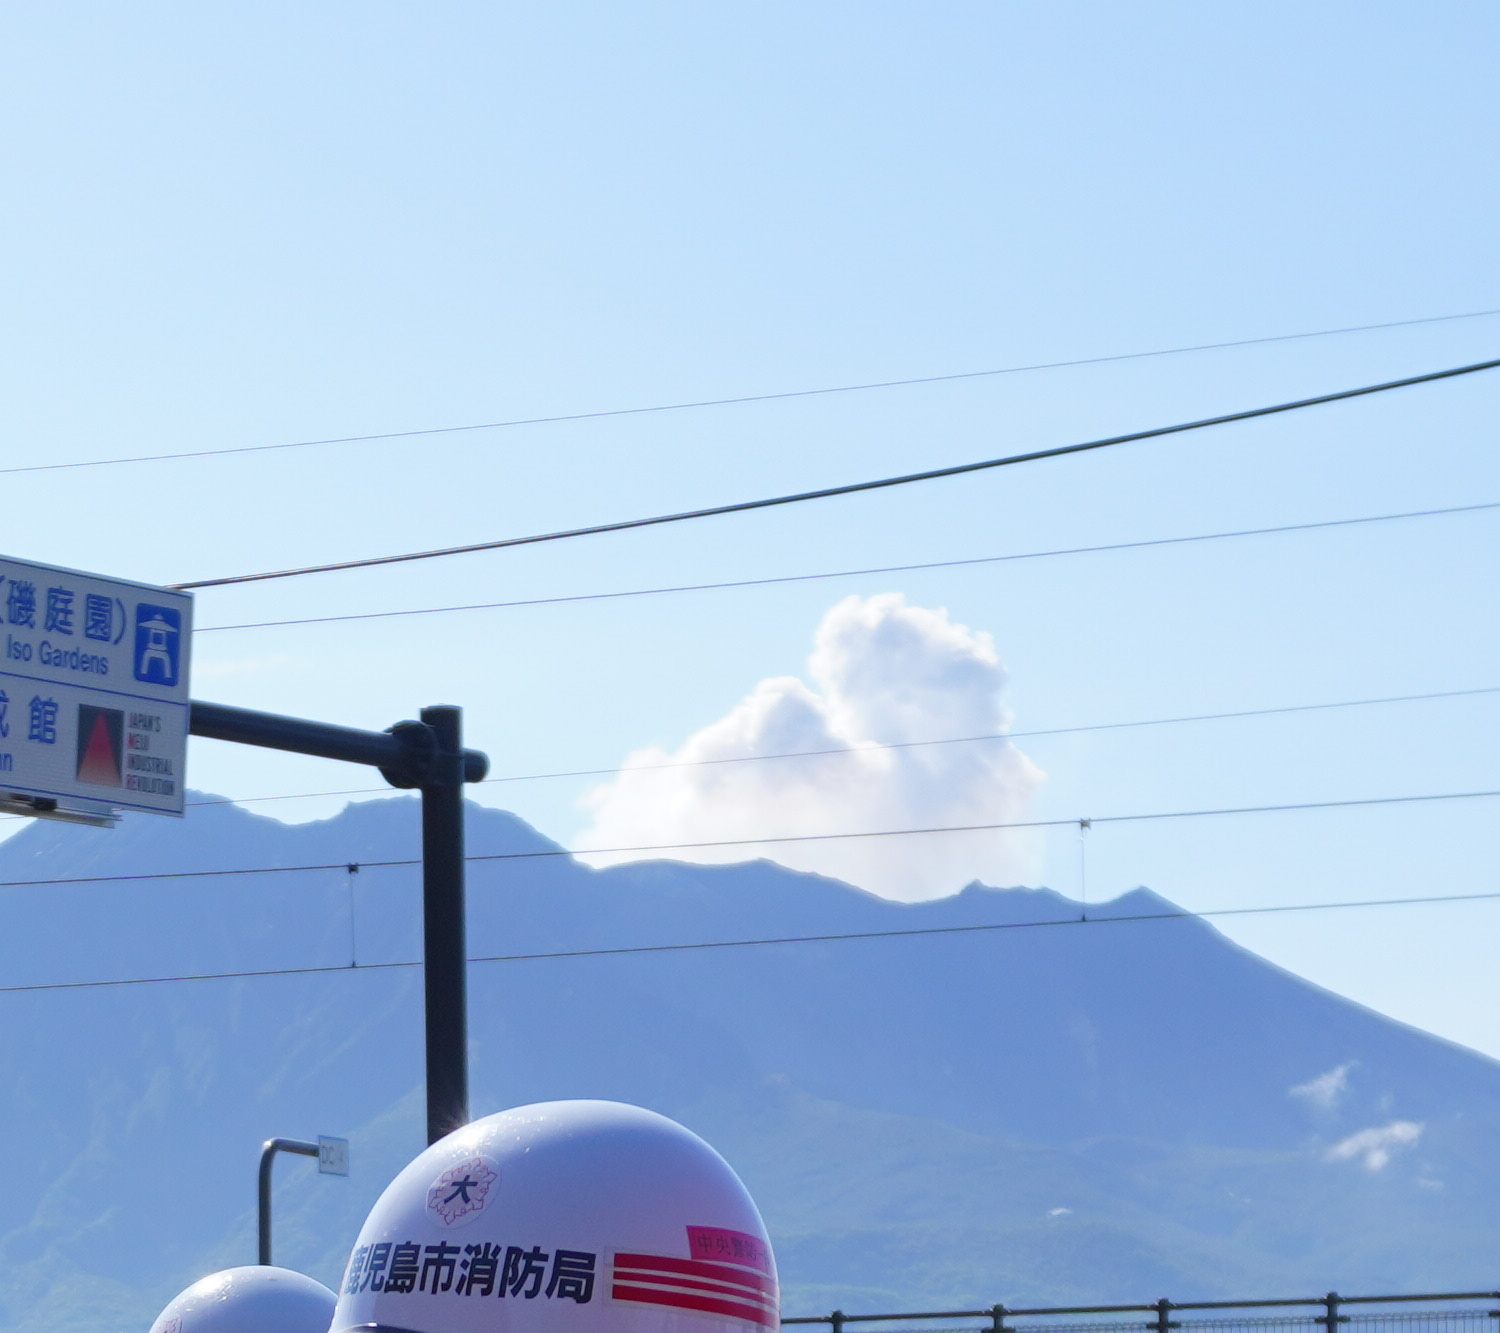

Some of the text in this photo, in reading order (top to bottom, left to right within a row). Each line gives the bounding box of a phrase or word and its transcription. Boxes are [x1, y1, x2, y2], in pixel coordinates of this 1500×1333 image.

[6, 633, 32, 662] Iso
[39, 639, 109, 676] Gardens
[444, 1174, 478, 1206] 大
[343, 1240, 598, 1304] 鹿児島市消防局
